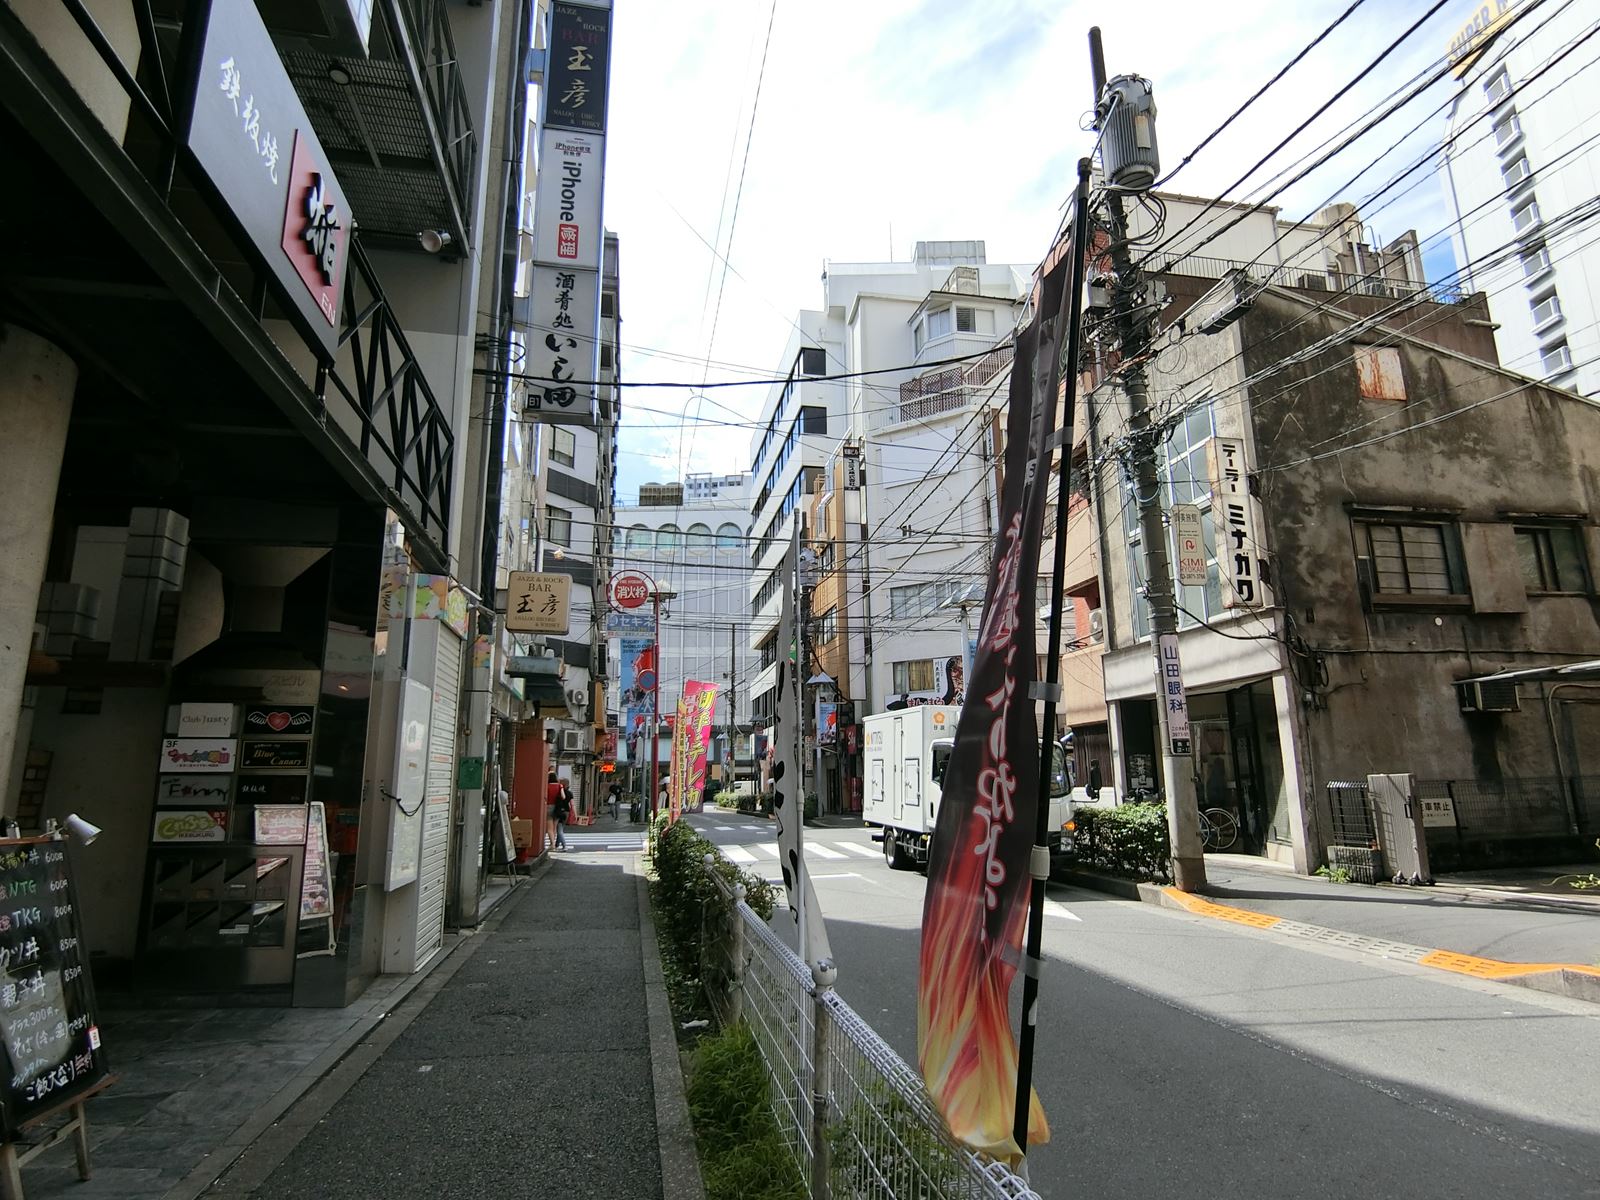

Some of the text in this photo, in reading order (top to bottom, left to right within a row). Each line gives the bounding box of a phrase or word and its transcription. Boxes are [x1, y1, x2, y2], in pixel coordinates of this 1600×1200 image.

[555, 6, 577, 15] JAZZ
[583, 23, 606, 32] ROCK
[1450, 8, 1492, 61] SUPER
[562, 29, 600, 44] BAR
[220, 57, 278, 185] 鉄板焼
[560, 161, 582, 221] iPhone
[320, 293, 336, 324] EN
[528, 396, 540, 406] B1
[1222, 444, 1254, 601] テーラー ミナガワ
[1180, 558, 1203, 566] KIMI
[528, 583, 552, 592] BAR
[617, 585, 646, 599] 消火栓
[516, 593, 560, 616] 玉彦
[1163, 646, 1185, 714] 山田眼科
[254, 749, 274, 758] Blue
